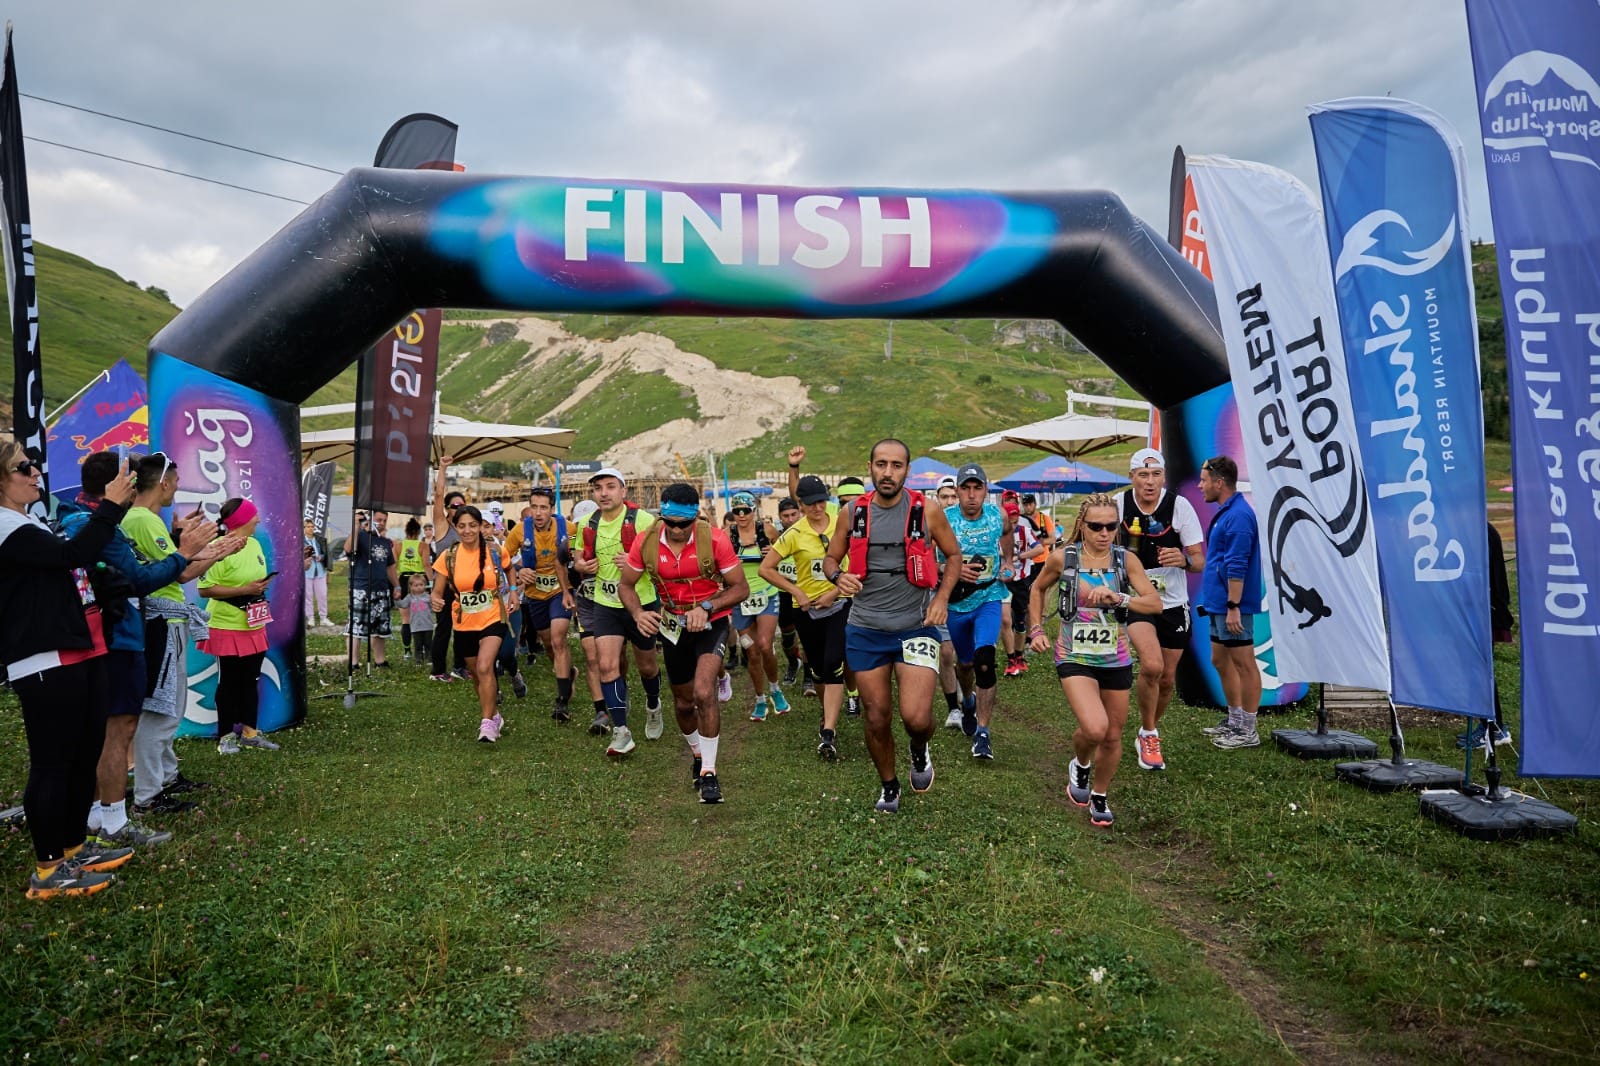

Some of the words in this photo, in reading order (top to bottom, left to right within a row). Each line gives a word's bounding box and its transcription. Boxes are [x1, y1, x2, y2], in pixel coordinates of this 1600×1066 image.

[565, 187, 931, 269] FINISH
[461, 593, 487, 606] 420
[247, 605, 268, 621] 175
[1074, 629, 1111, 644] 442
[905, 642, 936, 659] 425
